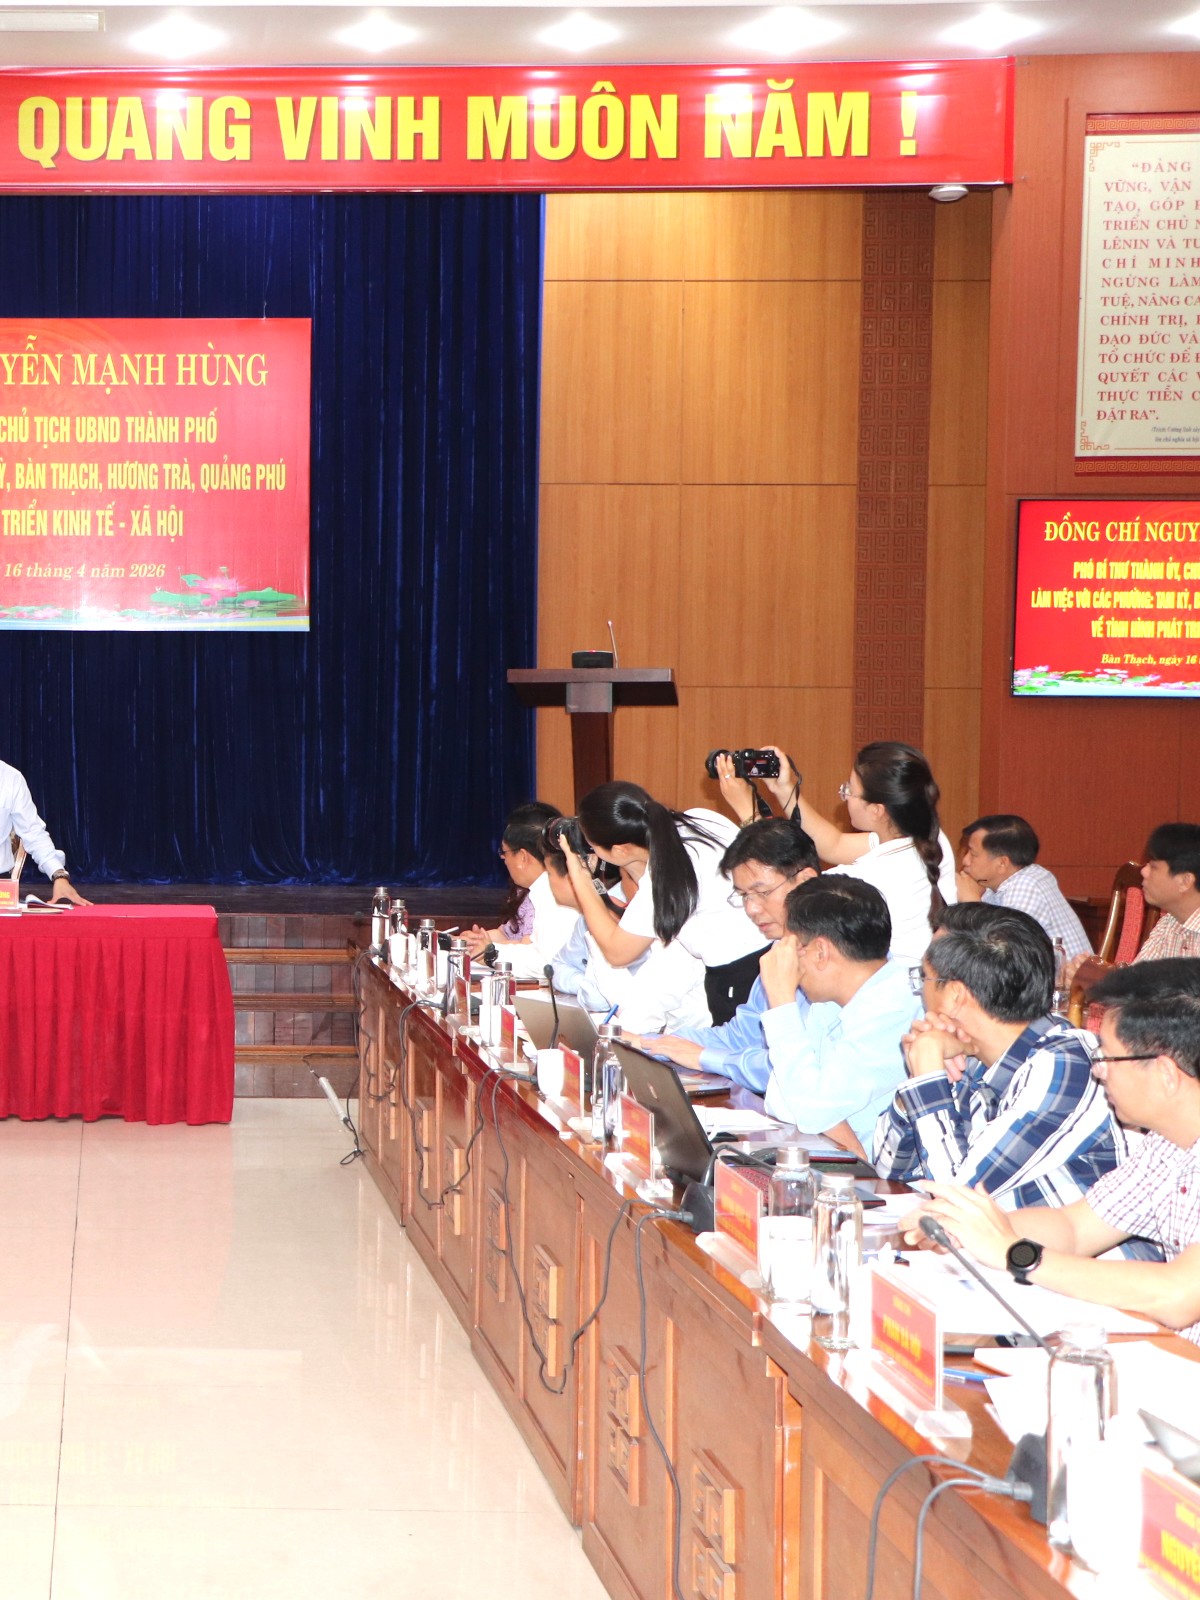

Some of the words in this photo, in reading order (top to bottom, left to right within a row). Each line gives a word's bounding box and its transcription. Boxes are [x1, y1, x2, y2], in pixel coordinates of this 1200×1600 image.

[17, 96, 250, 169] QUANG
[277, 96, 441, 162] VINH
[467, 81, 679, 160] MUÔN
[704, 78, 870, 158] NĂM
[900, 91, 918, 156] !
[1160, 178, 1192, 194] VẬN
[1150, 197, 1185, 211] GÓP
[1156, 215, 1189, 230] CHỦ
[1102, 236, 1150, 250] LÊNIN
[1157, 235, 1176, 249] VÀ
[1102, 256, 1137, 269] CHÍ
[1148, 257, 1200, 268] MINH
[1138, 293, 1180, 307] NÂNG
[1100, 312, 1149, 326] CHÍNH
[1100, 334, 1131, 347] ĐẠO
[1139, 330, 1171, 345] ĐỨC
[1179, 330, 1199, 344] VÀ
[1098, 347, 1119, 364] TỔ
[1124, 350, 1166, 364] CHỨC
[1170, 346, 1191, 363] ĐỂ
[72, 354, 166, 395] MẠNH
[176, 341, 269, 386] HÙNG
[1158, 368, 1188, 382] CÁC
[1097, 390, 1139, 405] THỰC
[1147, 386, 1184, 401] TIỄN
[1096, 408, 1127, 423] ĐẶT
[34, 416, 71, 449] TỊCH
[75, 416, 121, 443] UBND
[125, 410, 179, 443] THÀNH
[184, 407, 219, 443] PHỐ
[15, 458, 47, 490] BÀN
[51, 463, 104, 496] THẠCH,
[108, 460, 159, 490] HƯƠNG
[163, 458, 196, 493] TRÀ,
[200, 454, 251, 492] QUẢNG
[256, 457, 286, 490] PHÚ
[2, 499, 48, 536] TRIỂN
[52, 510, 92, 536] KINH
[96, 501, 116, 536] TẾ
[130, 504, 152, 536] XÃ
[156, 506, 184, 543] HỘI
[1044, 511, 1101, 542] ĐỒNG
[1105, 516, 1141, 542] CHÍ
[4, 563, 23, 578] 16
[26, 562, 73, 580] tháng
[76, 564, 86, 577] 4
[90, 563, 126, 578] năm
[129, 564, 166, 578] 2026
[1073, 558, 1095, 580] PHÓ
[1096, 558, 1108, 580] BÍ
[1109, 560, 1131, 580] THƯ
[1132, 558, 1165, 580] THÀNH
[1166, 556, 1181, 582] ỦY,
[1031, 587, 1052, 608] LÀM
[1054, 587, 1074, 613] VIỆC
[1076, 587, 1091, 608] VỚI
[1093, 587, 1112, 608] CÁC
[1114, 586, 1154, 608] PHƯỜNG:
[1156, 591, 1175, 609] TAM
[1177, 588, 1192, 611] KỲ,
[1091, 615, 1104, 638] VỀ
[1106, 616, 1129, 638] TÌNH
[1130, 616, 1155, 638] HÌNH
[1157, 616, 1183, 639] PHÁT
[1101, 654, 1121, 664] Bàn
[1123, 654, 1157, 666] Thạch,
[1159, 654, 1183, 667] ngày
[1185, 655, 1197, 665] 16
